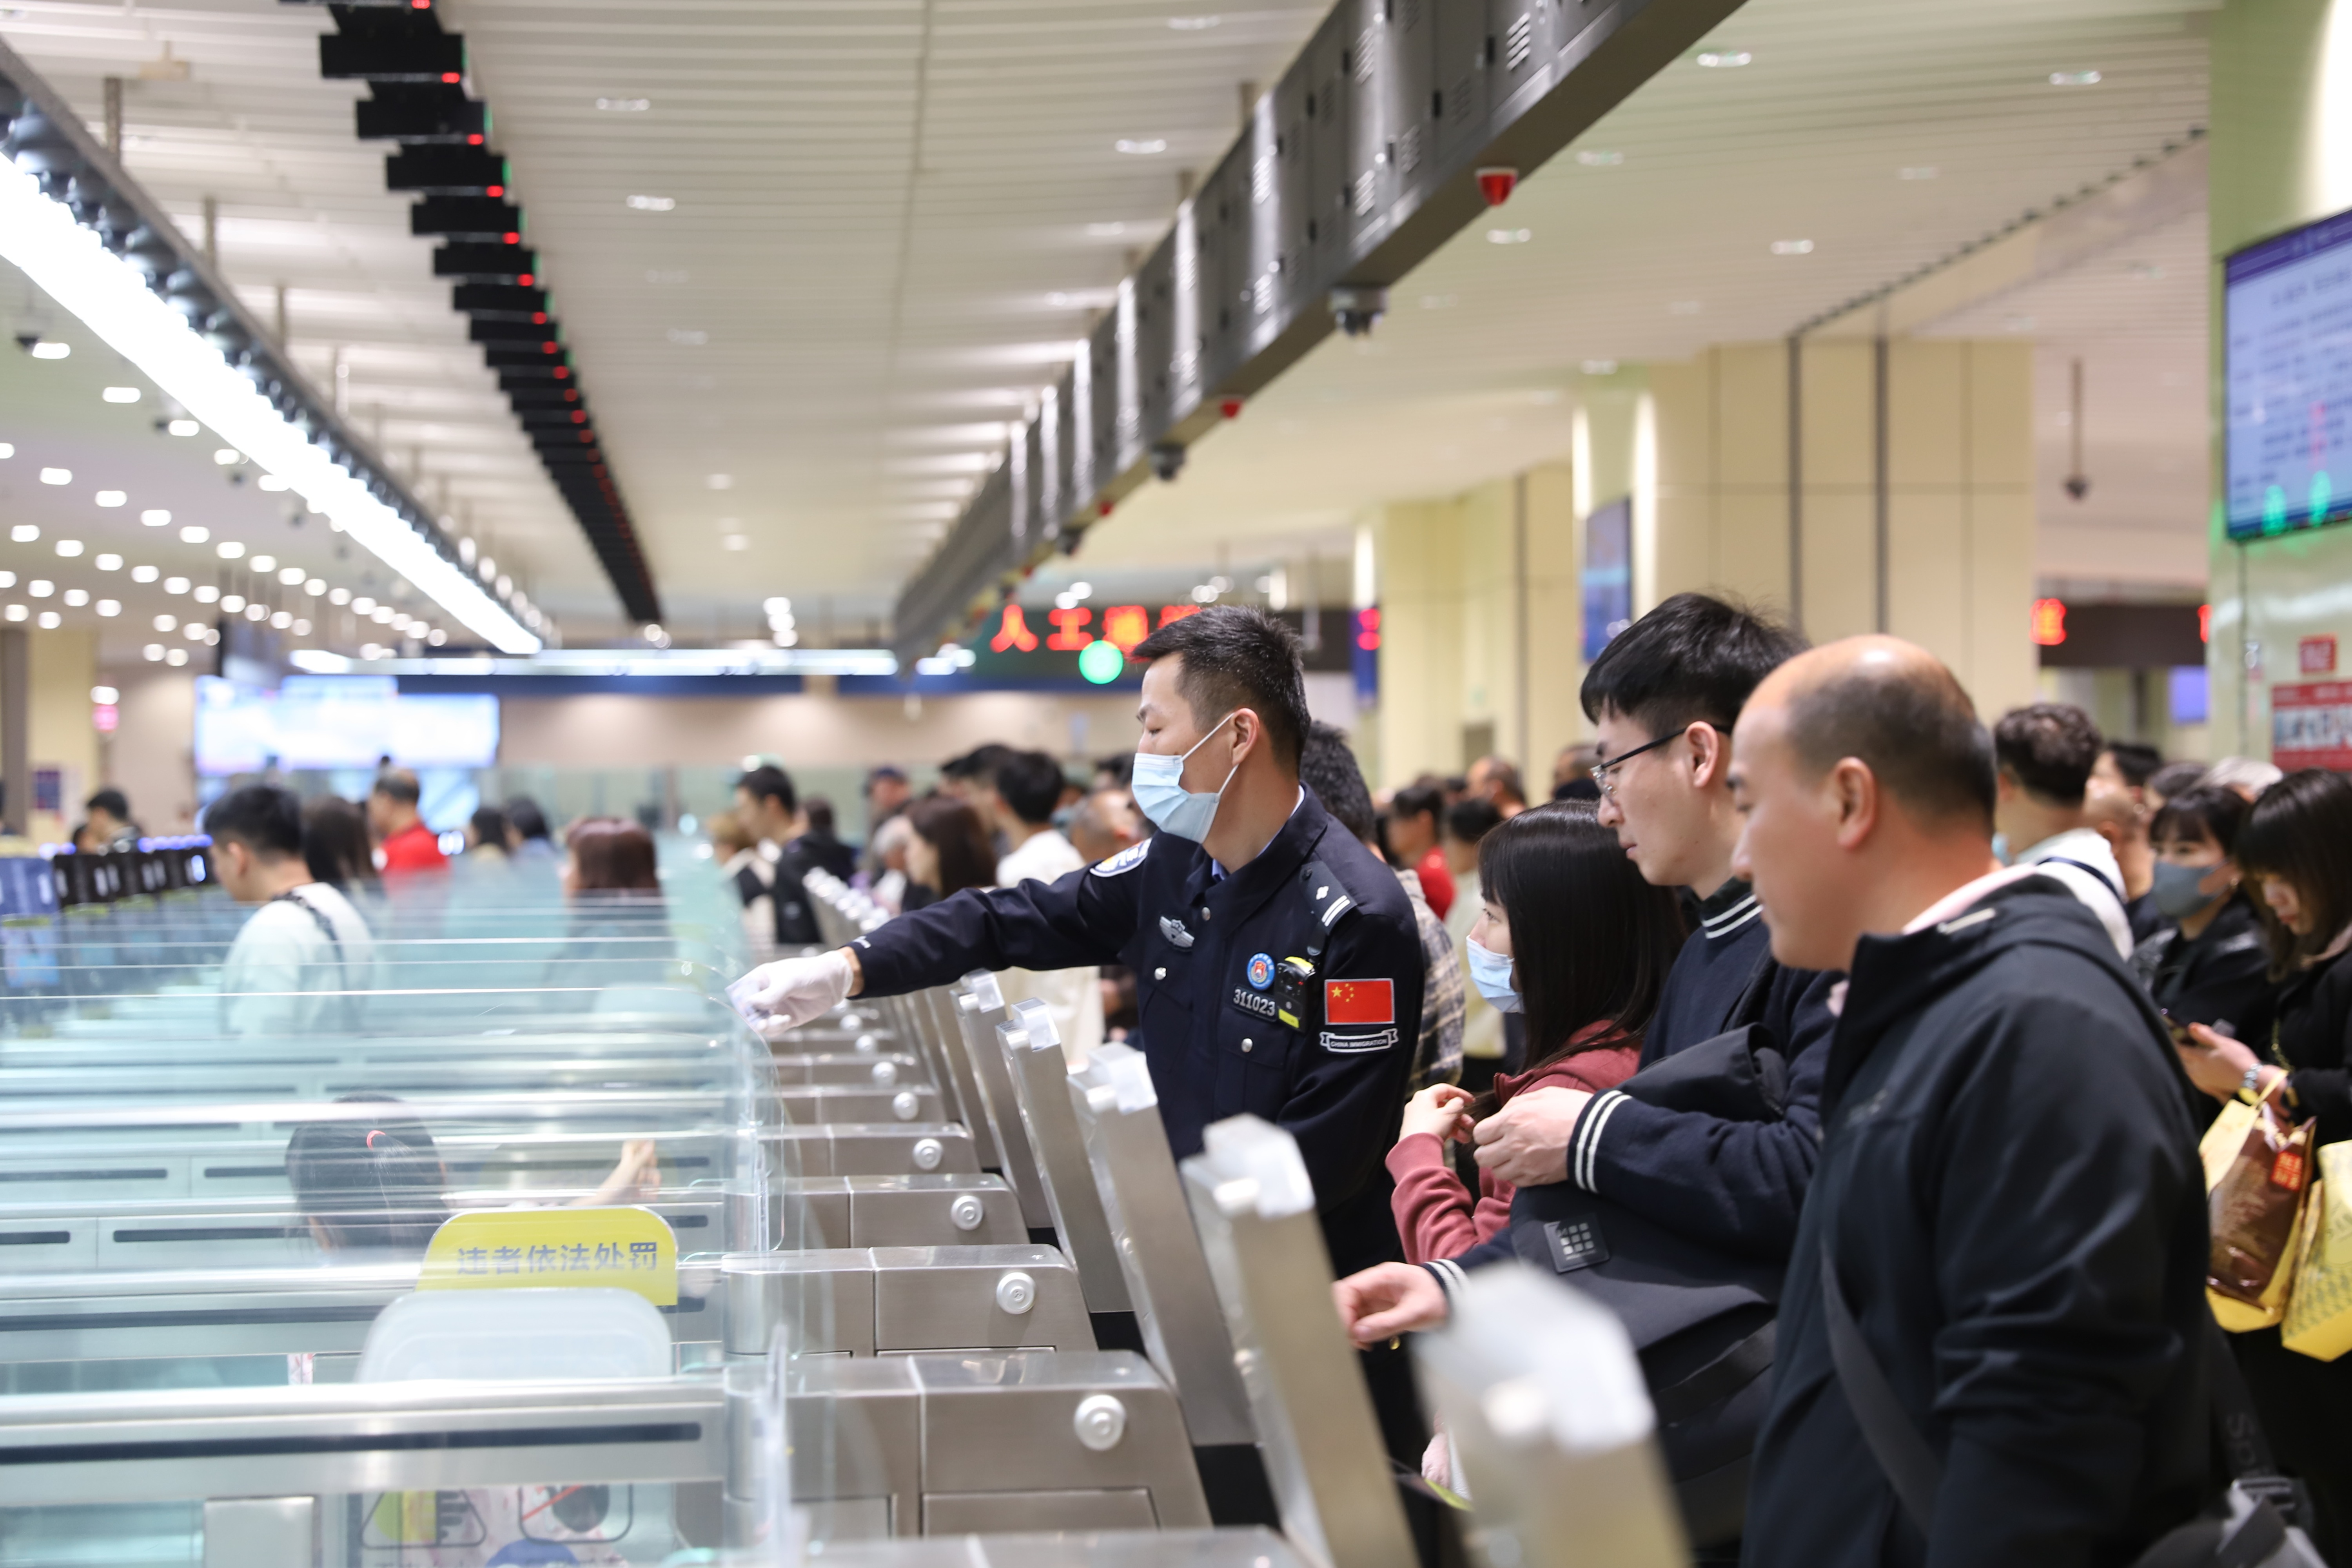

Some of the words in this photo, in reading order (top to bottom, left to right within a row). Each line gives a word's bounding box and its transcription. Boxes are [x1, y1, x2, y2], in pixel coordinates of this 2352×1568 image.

[1233, 988, 1276, 1016] 311023
[1349, 1038, 1387, 1048] IMMIGRATION
[456, 1241, 658, 1276] 违者依法处罚
